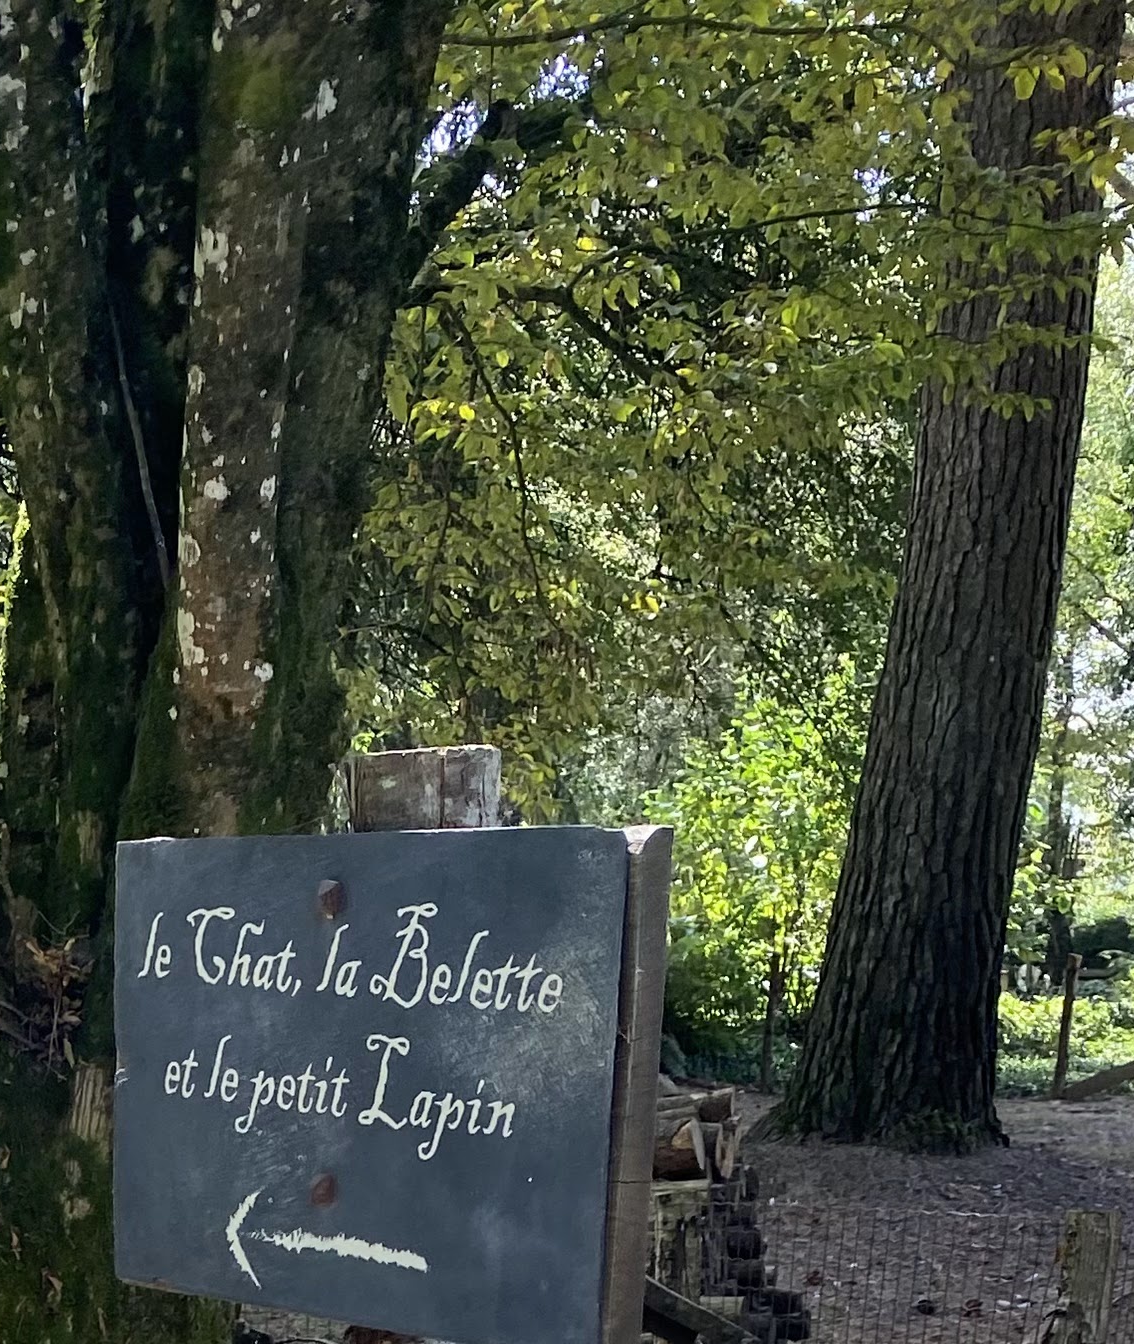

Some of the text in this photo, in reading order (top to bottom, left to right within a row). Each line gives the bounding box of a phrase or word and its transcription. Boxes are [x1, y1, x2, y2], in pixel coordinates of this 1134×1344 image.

[137, 902, 566, 1016] le Chat, la Belette
[164, 1034, 516, 1161] et le petit Lapin
